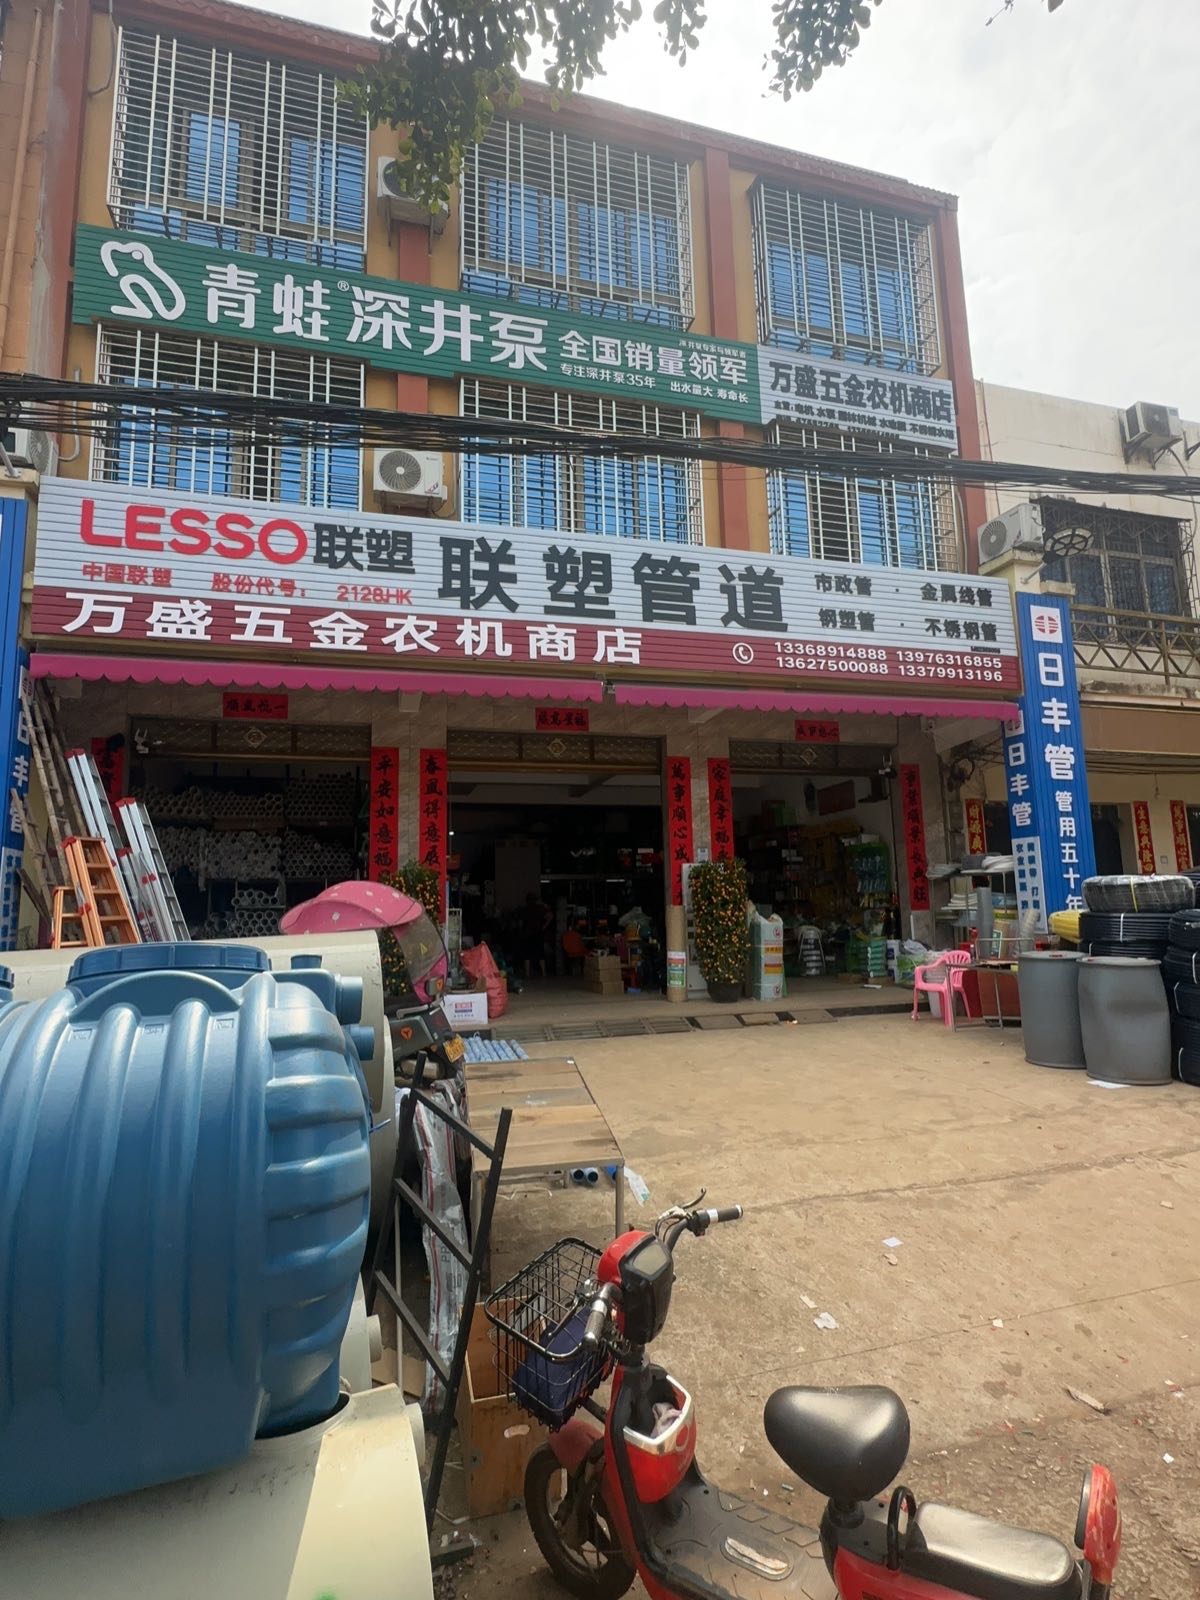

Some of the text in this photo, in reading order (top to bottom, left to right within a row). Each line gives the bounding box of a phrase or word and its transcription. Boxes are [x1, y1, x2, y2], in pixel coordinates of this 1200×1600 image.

[558, 330, 748, 386] 全国销量领军
[560, 363, 657, 389] 专注深井泵35年
[717, 389, 749, 404] 寿命长
[769, 361, 952, 424] 万盛五金农机商店
[80, 497, 416, 575] LESSO 联塑
[82, 561, 172, 588] 中国联塑
[438, 536, 788, 633] 联塑管道
[814, 573, 872, 597] 市政管
[920, 582, 993, 608] 金属线管
[61, 591, 643, 666] 万盛五金农机商店
[818, 608, 875, 632] 钢塑管
[924, 618, 997, 642] 不锈钢管
[774, 641, 1002, 669] 13368914888 13976316855
[776, 657, 1003, 682] 13627500088 13379913196
[1038, 652, 1075, 780] 日丰管
[1007, 742, 1033, 827] 日丰管
[420, 754, 443, 876] 春風得意展
[1055, 790, 1084, 910] 管用五十年
